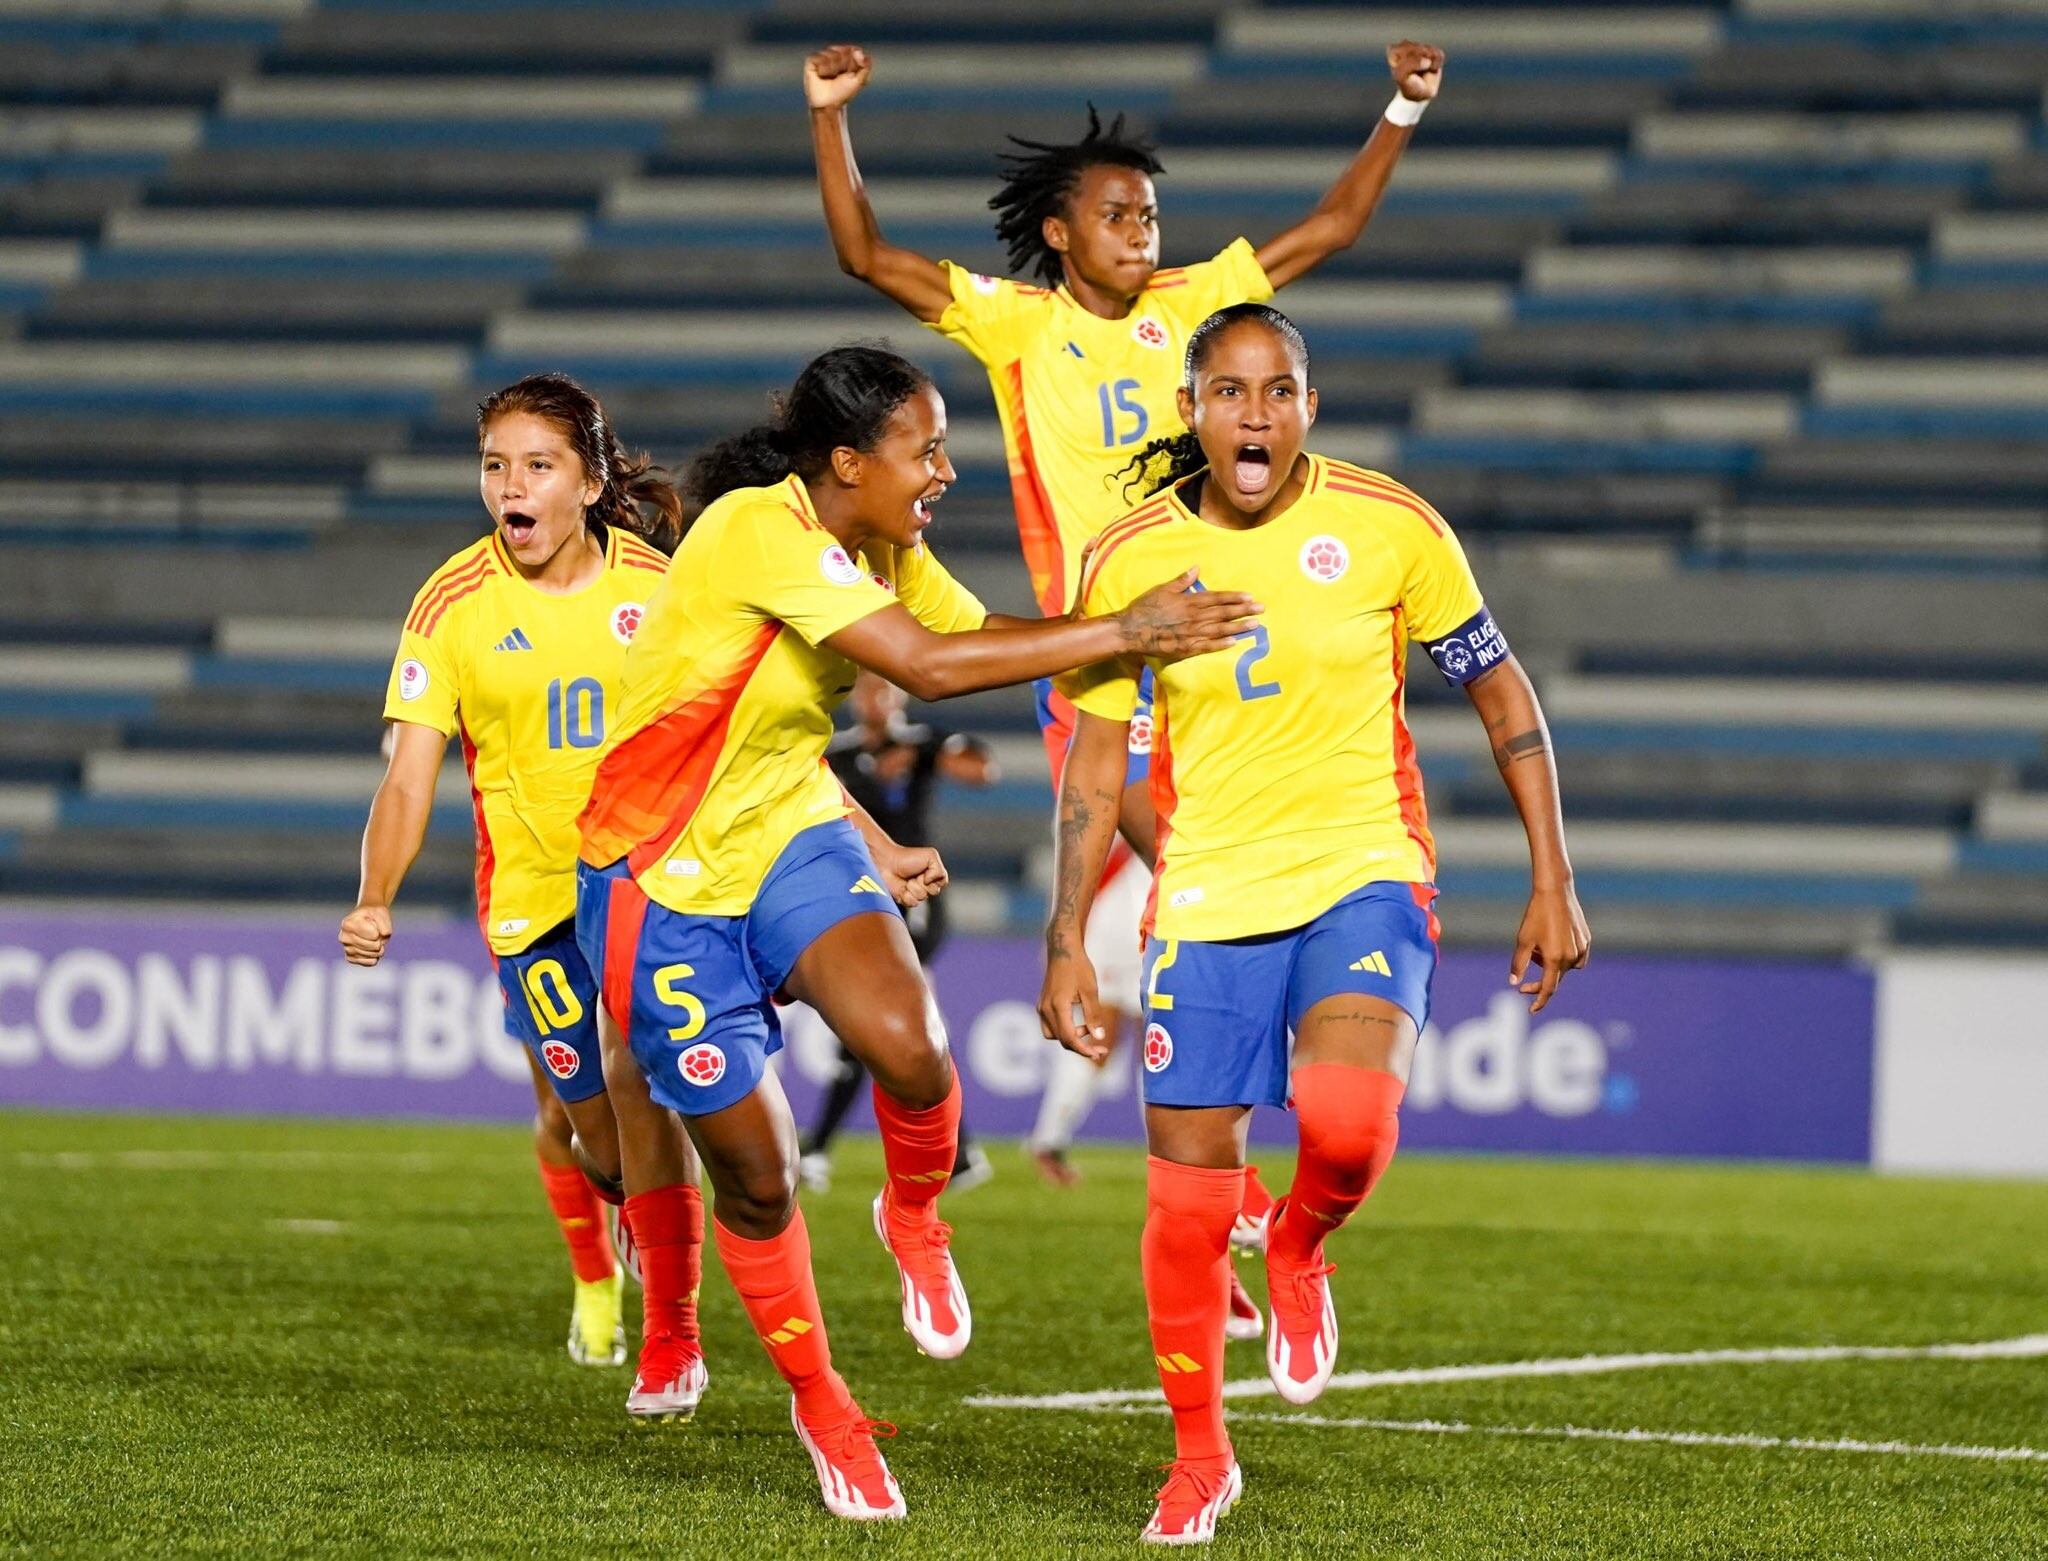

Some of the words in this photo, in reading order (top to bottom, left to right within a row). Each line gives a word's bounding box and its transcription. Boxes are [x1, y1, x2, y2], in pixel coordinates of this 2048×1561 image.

[1098, 379, 1148, 447] 15
[1232, 624, 1281, 701] 2
[547, 677, 605, 749] 10
[518, 959, 583, 1036] 10
[653, 964, 706, 1041] 5
[1148, 939, 1179, 1010] 2
